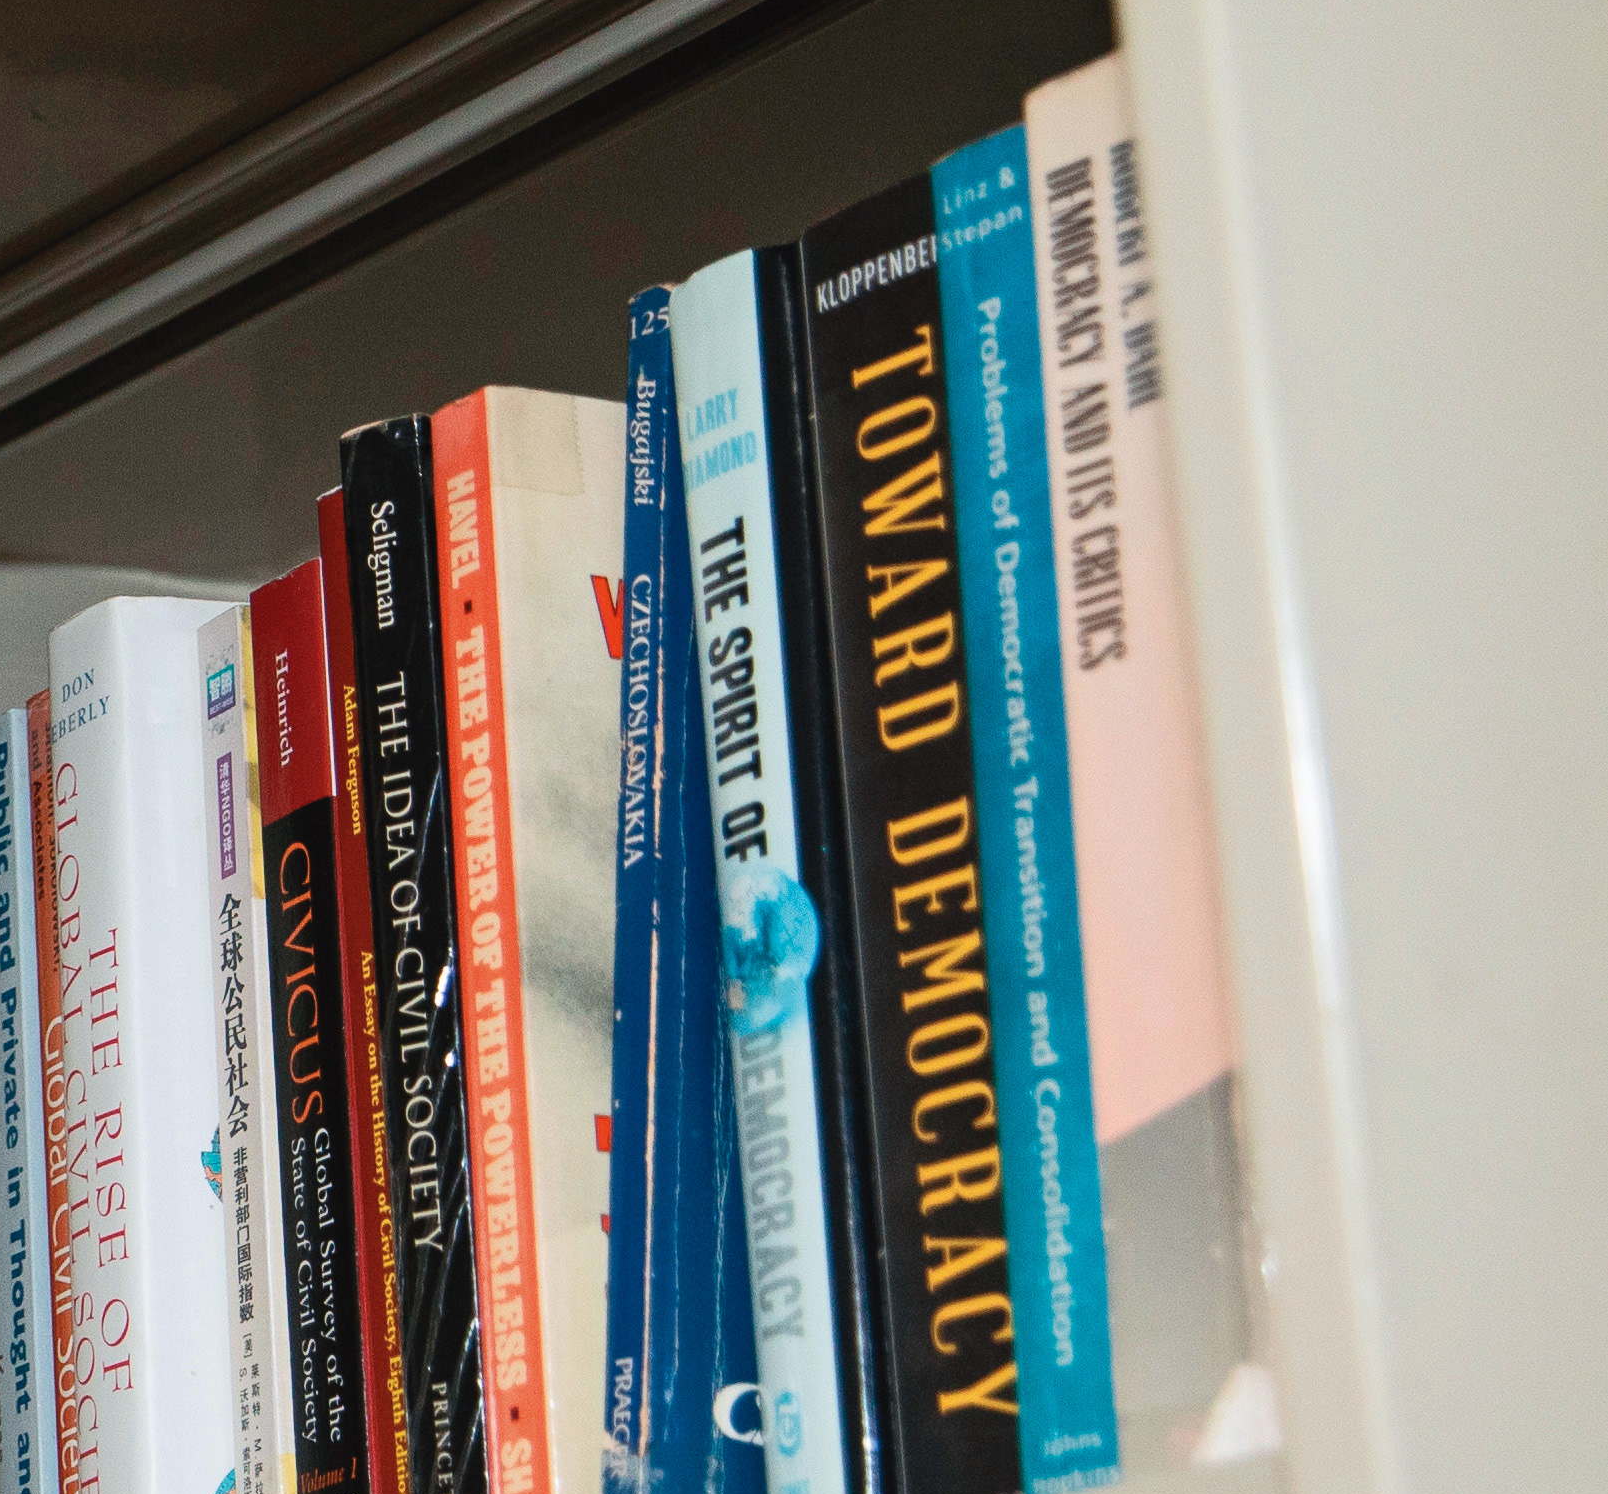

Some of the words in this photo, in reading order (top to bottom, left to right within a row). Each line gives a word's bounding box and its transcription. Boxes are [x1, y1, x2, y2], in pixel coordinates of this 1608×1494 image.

[941, 202, 1023, 251] Stepan
[1047, 157, 1106, 367] DEMOCRACY
[628, 306, 671, 341] 125
[976, 298, 1008, 479] Problems
[1062, 382, 1112, 454] AND
[630, 375, 659, 508] Bugajski
[1067, 460, 1115, 520] ITS
[447, 470, 480, 589] HAVEL
[853, 325, 968, 752] TOWARD
[993, 488, 1015, 529] of
[368, 501, 396, 631] Seligman
[700, 518, 748, 620] THE
[1072, 525, 1128, 673] CRITICS
[60, 668, 96, 704] DON
[455, 625, 489, 730] THE
[995, 538, 1030, 770] Democratic
[274, 648, 294, 768] Heinrich
[343, 684, 358, 741] Adam
[376, 671, 410, 758] THE
[621, 574, 654, 869] CZECHOSLOVAKIA
[708, 632, 763, 786] SPIRIT
[346, 743, 361, 836] Ferguson
[383, 770, 416, 870] IDEA
[461, 738, 500, 907] POWER
[721, 795, 767, 863] OF
[54, 761, 84, 1045] GLOBAL
[390, 880, 420, 934] OF
[1011, 776, 1044, 977] Transition
[279, 840, 324, 1125] CIVICUS
[361, 950, 374, 979] An
[470, 912, 503, 974] OF
[88, 927, 122, 1076] THE
[217, 891, 253, 1138] 全球公民社会
[363, 982, 377, 1040] Essay
[395, 947, 431, 1064] CIVIL
[473, 979, 511, 1087] THE
[1028, 989, 1058, 1067] and
[1, 986, 20, 1150] Private
[368, 1042, 379, 1066] on
[369, 1067, 382, 1106] the
[372, 1109, 386, 1189] History
[887, 797, 1020, 1415] DEMOCRACY
[7, 1166, 22, 1209] in
[65, 1069, 91, 1265] CIVIL
[93, 1101, 129, 1269] RISE
[291, 1135, 307, 1212] State
[313, 1126, 335, 1227] Global
[377, 1192, 390, 1216] of
[403, 1074, 443, 1252] SOCIETY
[294, 1218, 311, 1253] of
[379, 1218, 394, 1270] Civil
[479, 1090, 527, 1390] POWERLESS
[1033, 1077, 1075, 1367] Consolidation
[8, 1218, 32, 1414] Thought
[297, 1254, 316, 1327] Civil
[319, 1239, 338, 1344] Survey
[383, 1271, 398, 1351] Society,
[100, 1297, 134, 1393] OF
[300, 1337, 318, 1444] Society
[326, 1352, 343, 1394] of
[388, 1356, 406, 1431] Eighth
[328, 1395, 346, 1443] the
[349, 1457, 359, 1481] 1
